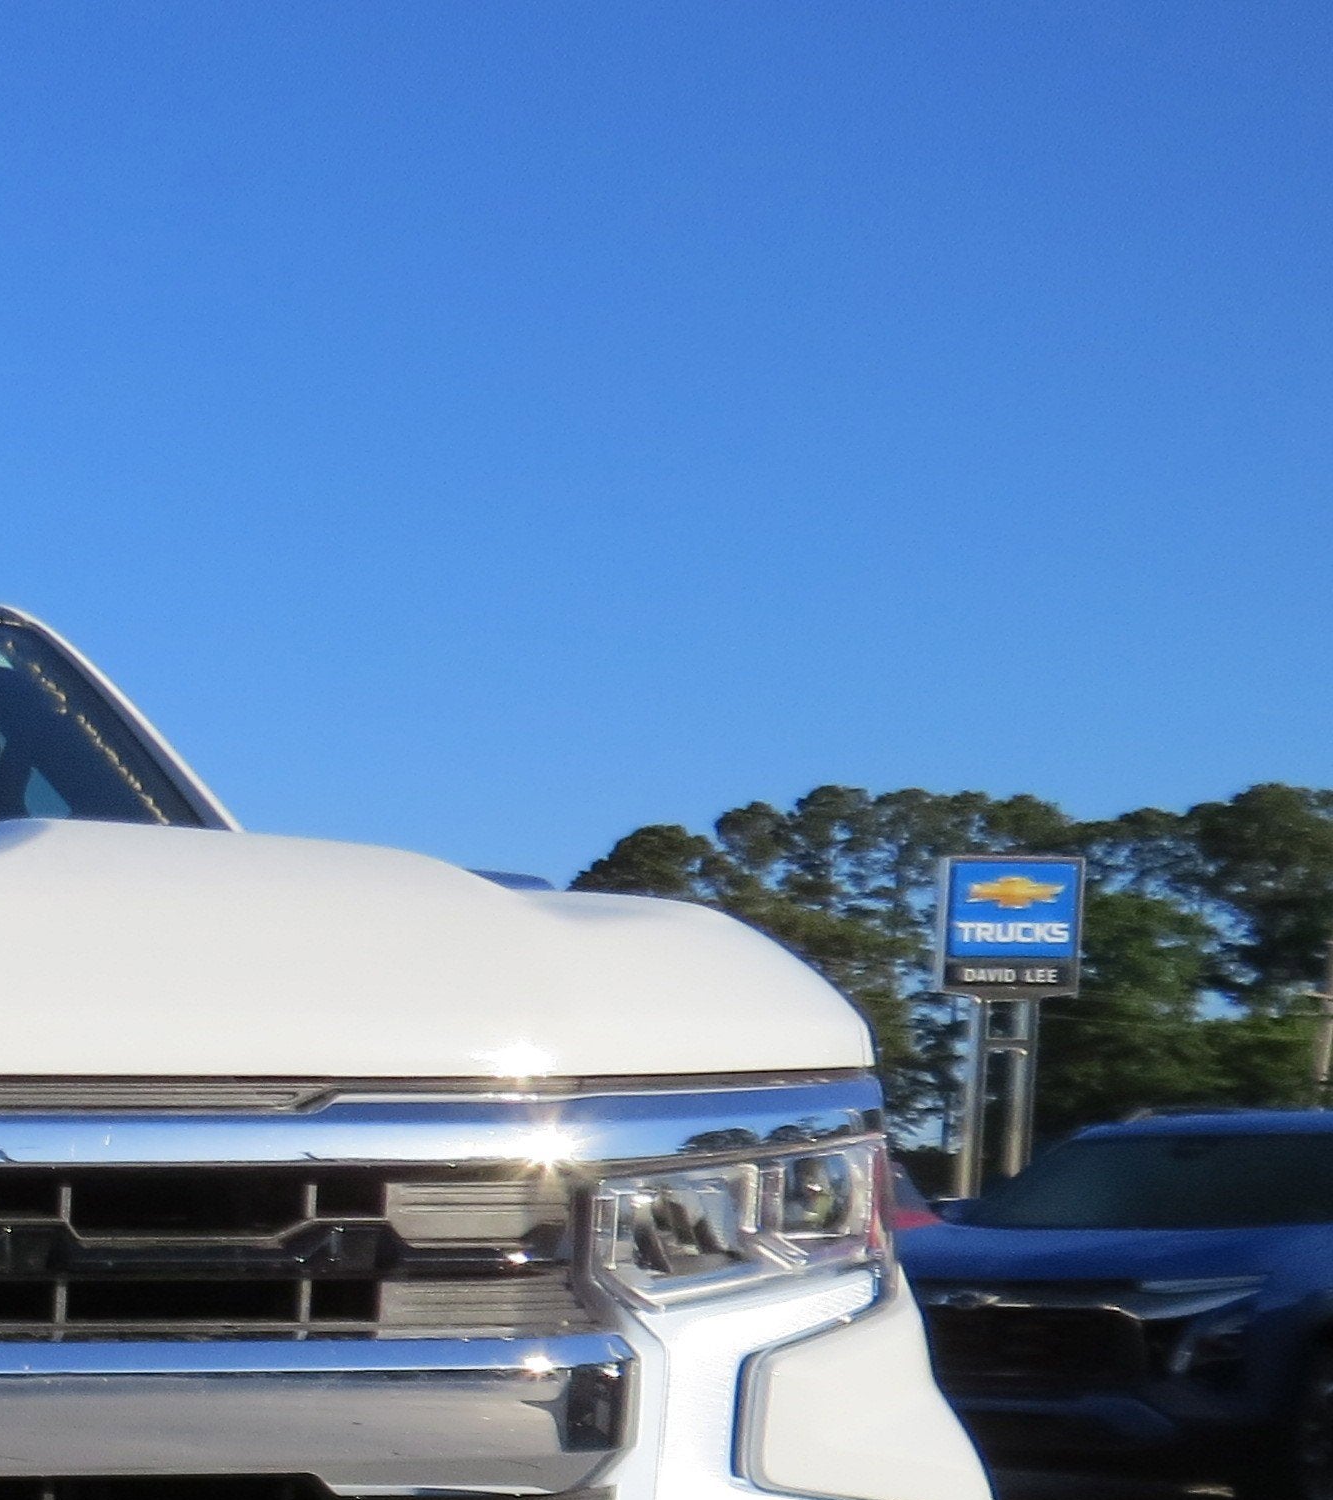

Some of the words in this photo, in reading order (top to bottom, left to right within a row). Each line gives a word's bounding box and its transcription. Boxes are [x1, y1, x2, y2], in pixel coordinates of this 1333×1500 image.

[956, 921, 1070, 943] TRUCKS
[962, 968, 1016, 983] DAVID
[1024, 968, 1059, 983] LEE
